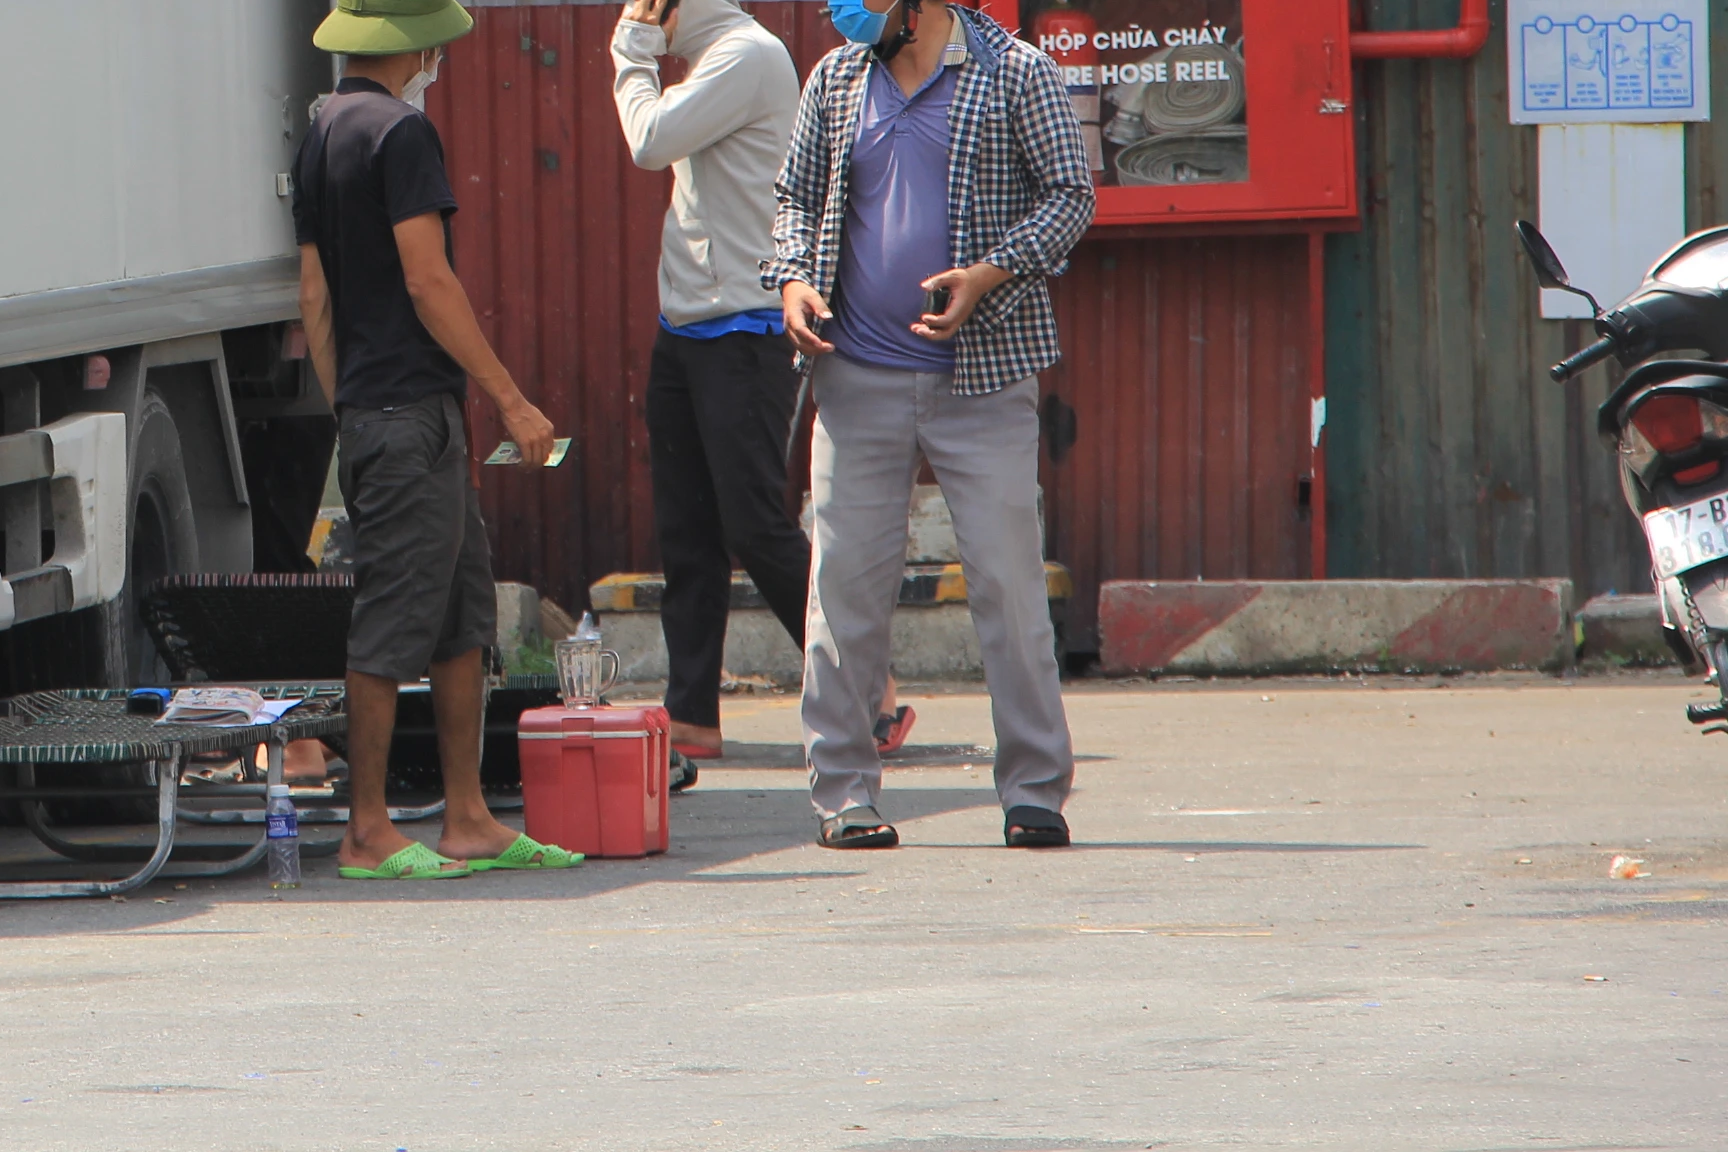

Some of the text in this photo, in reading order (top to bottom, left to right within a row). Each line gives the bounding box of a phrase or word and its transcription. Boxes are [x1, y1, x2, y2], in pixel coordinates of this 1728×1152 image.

[1039, 19, 1227, 57] HỘP CHỮA CHÁY
[1059, 60, 1231, 87] RE HOSE REEL
[1665, 495, 1728, 538] 17-B
